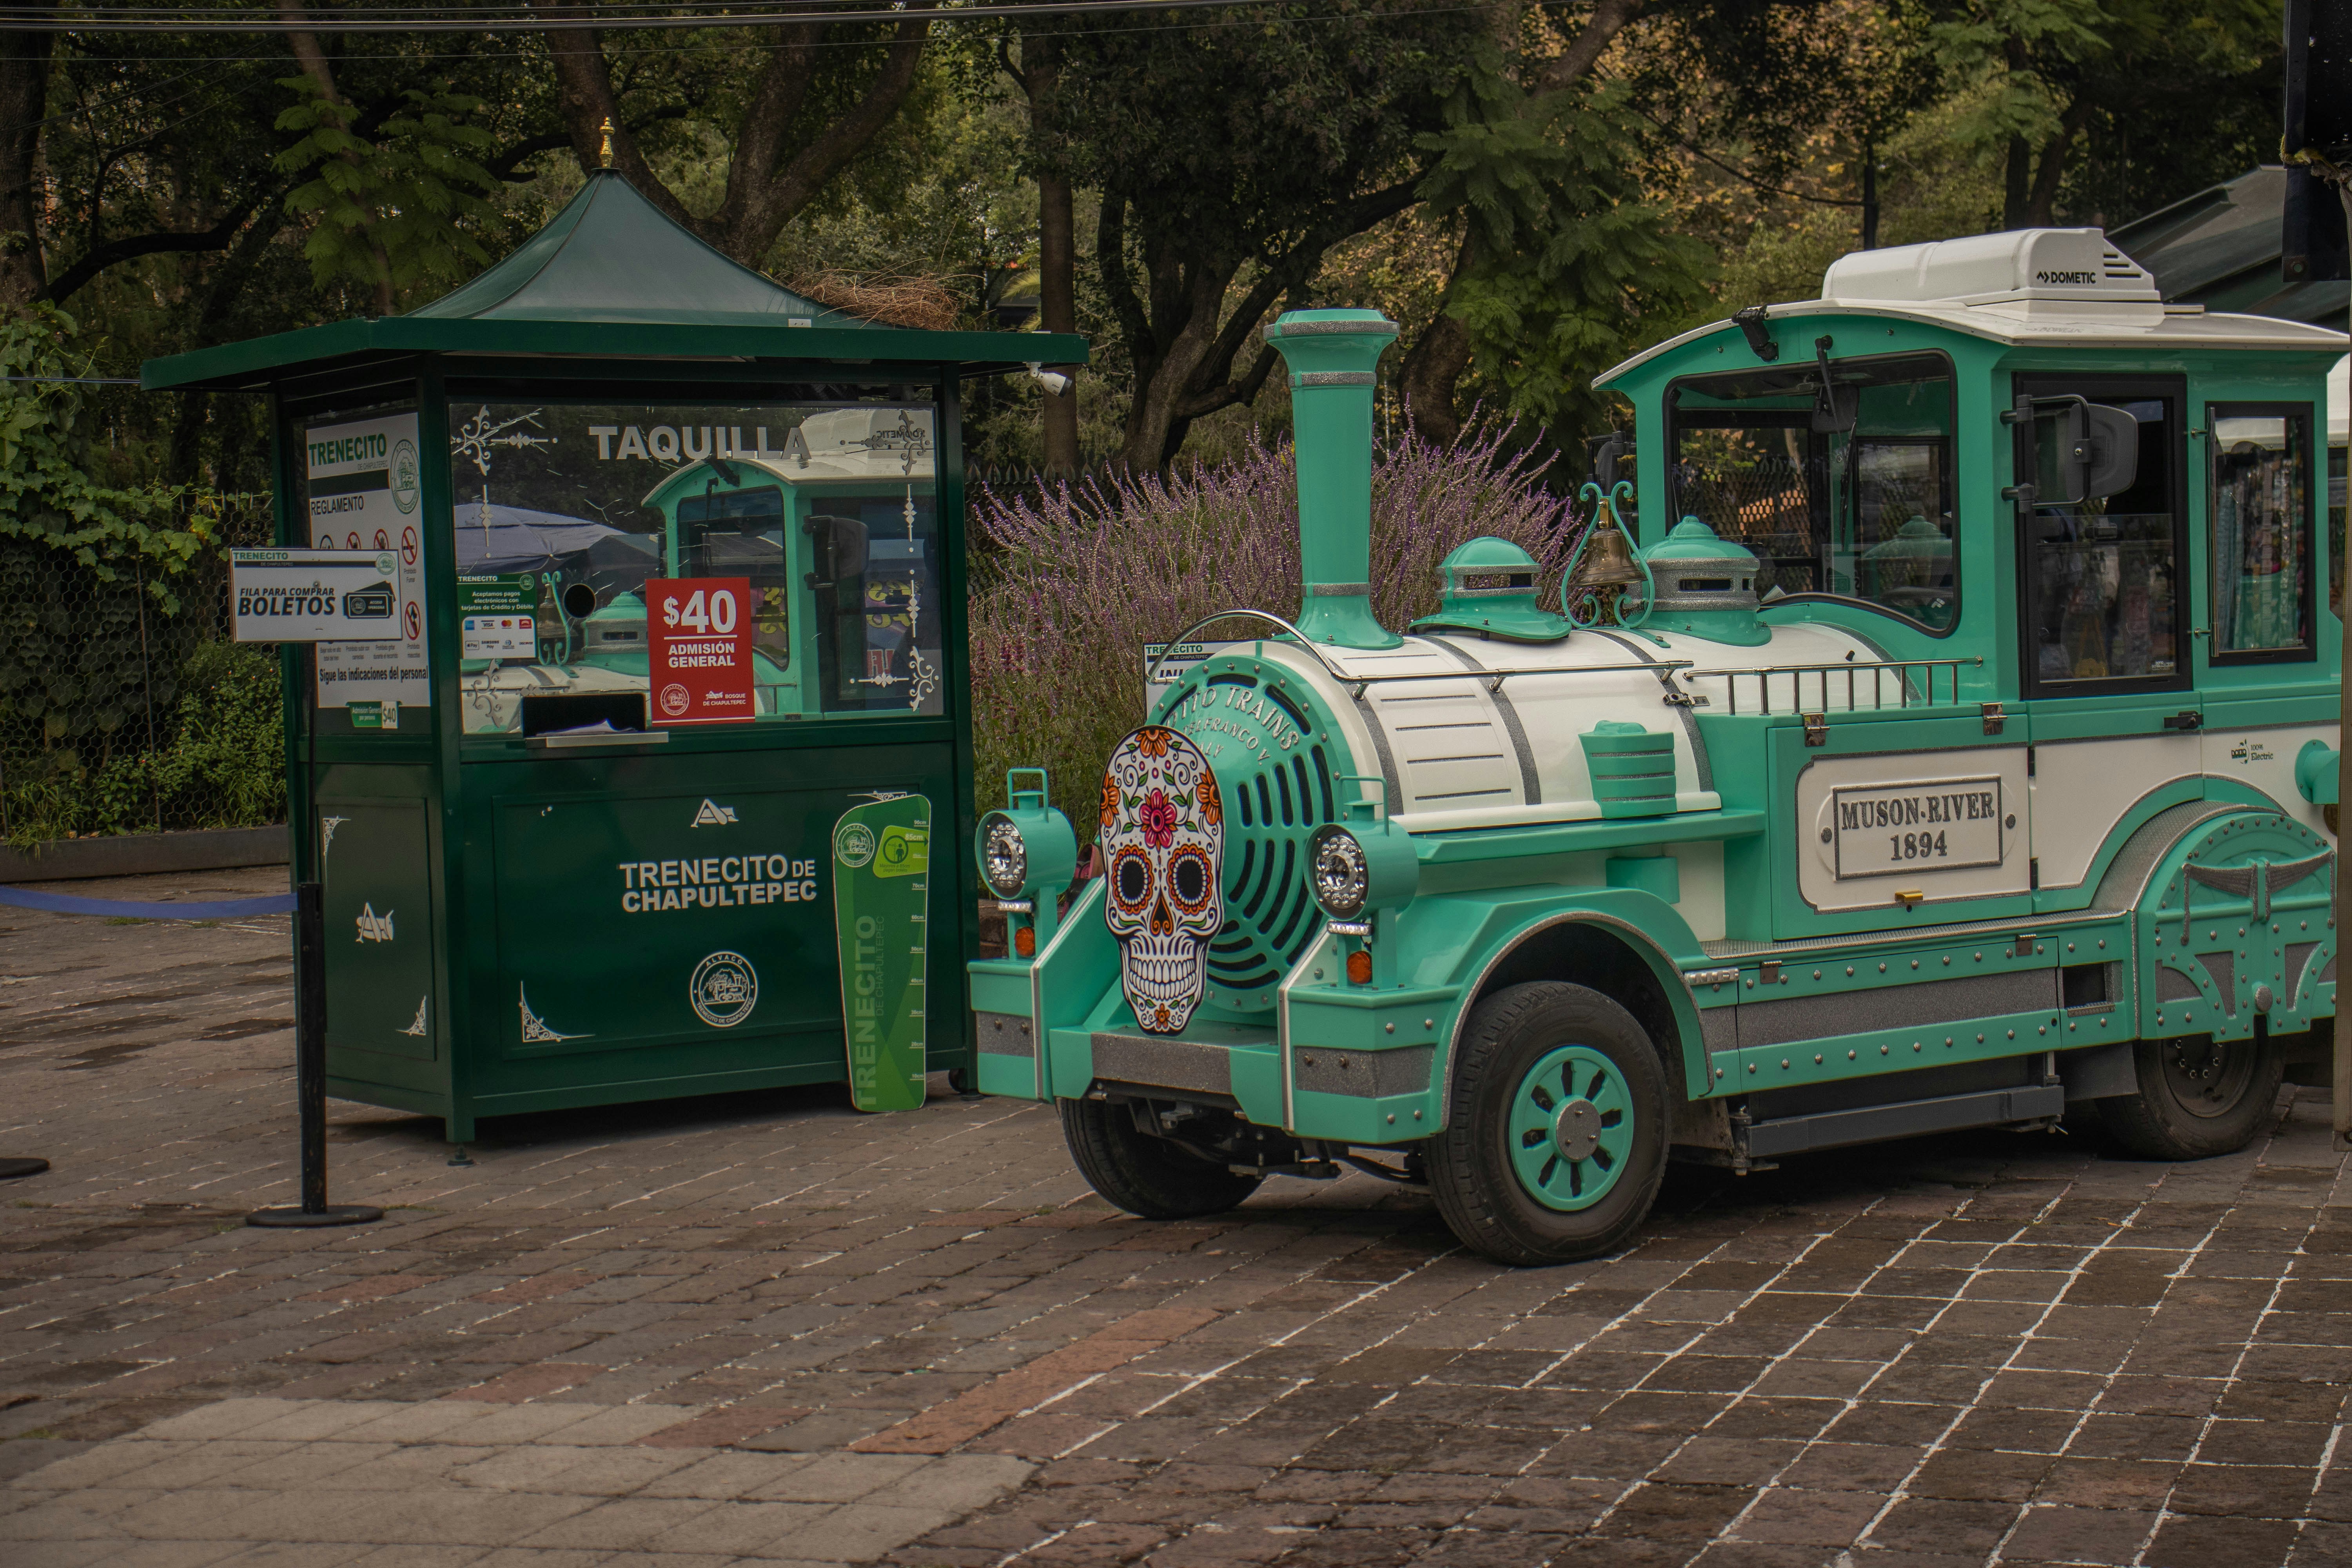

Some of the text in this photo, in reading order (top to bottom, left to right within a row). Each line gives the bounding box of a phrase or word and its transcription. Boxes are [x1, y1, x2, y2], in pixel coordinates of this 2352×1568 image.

[2051, 271, 2096, 284] DOMETIC
[309, 433, 387, 466] TRENECITO
[588, 426, 812, 461] TAQUILLA
[311, 495, 364, 515] REGLAMENTO
[238, 596, 336, 617] BOLETOS
[663, 590, 737, 633] $40
[668, 641, 735, 655] ADMISIÓN
[1146, 645, 1203, 654] TREECITO
[668, 656, 735, 668] GENERAL
[320, 665, 428, 684] Sigue las indicaciones del personal
[383, 707, 396, 725] $40
[1167, 686, 1299, 750] OTTO TRAINS
[2231, 749, 2247, 757] DOTTO
[2251, 752, 2273, 761] Electric
[1890, 829, 1947, 861] 1894
[619, 855, 815, 889] TRENECITO DE
[622, 880, 817, 913] CHAPULTEPEC
[706, 955, 744, 967] ALVACO
[876, 916, 884, 1016] DE CHAPULTEPEC
[855, 915, 876, 1107] TRENECITO
